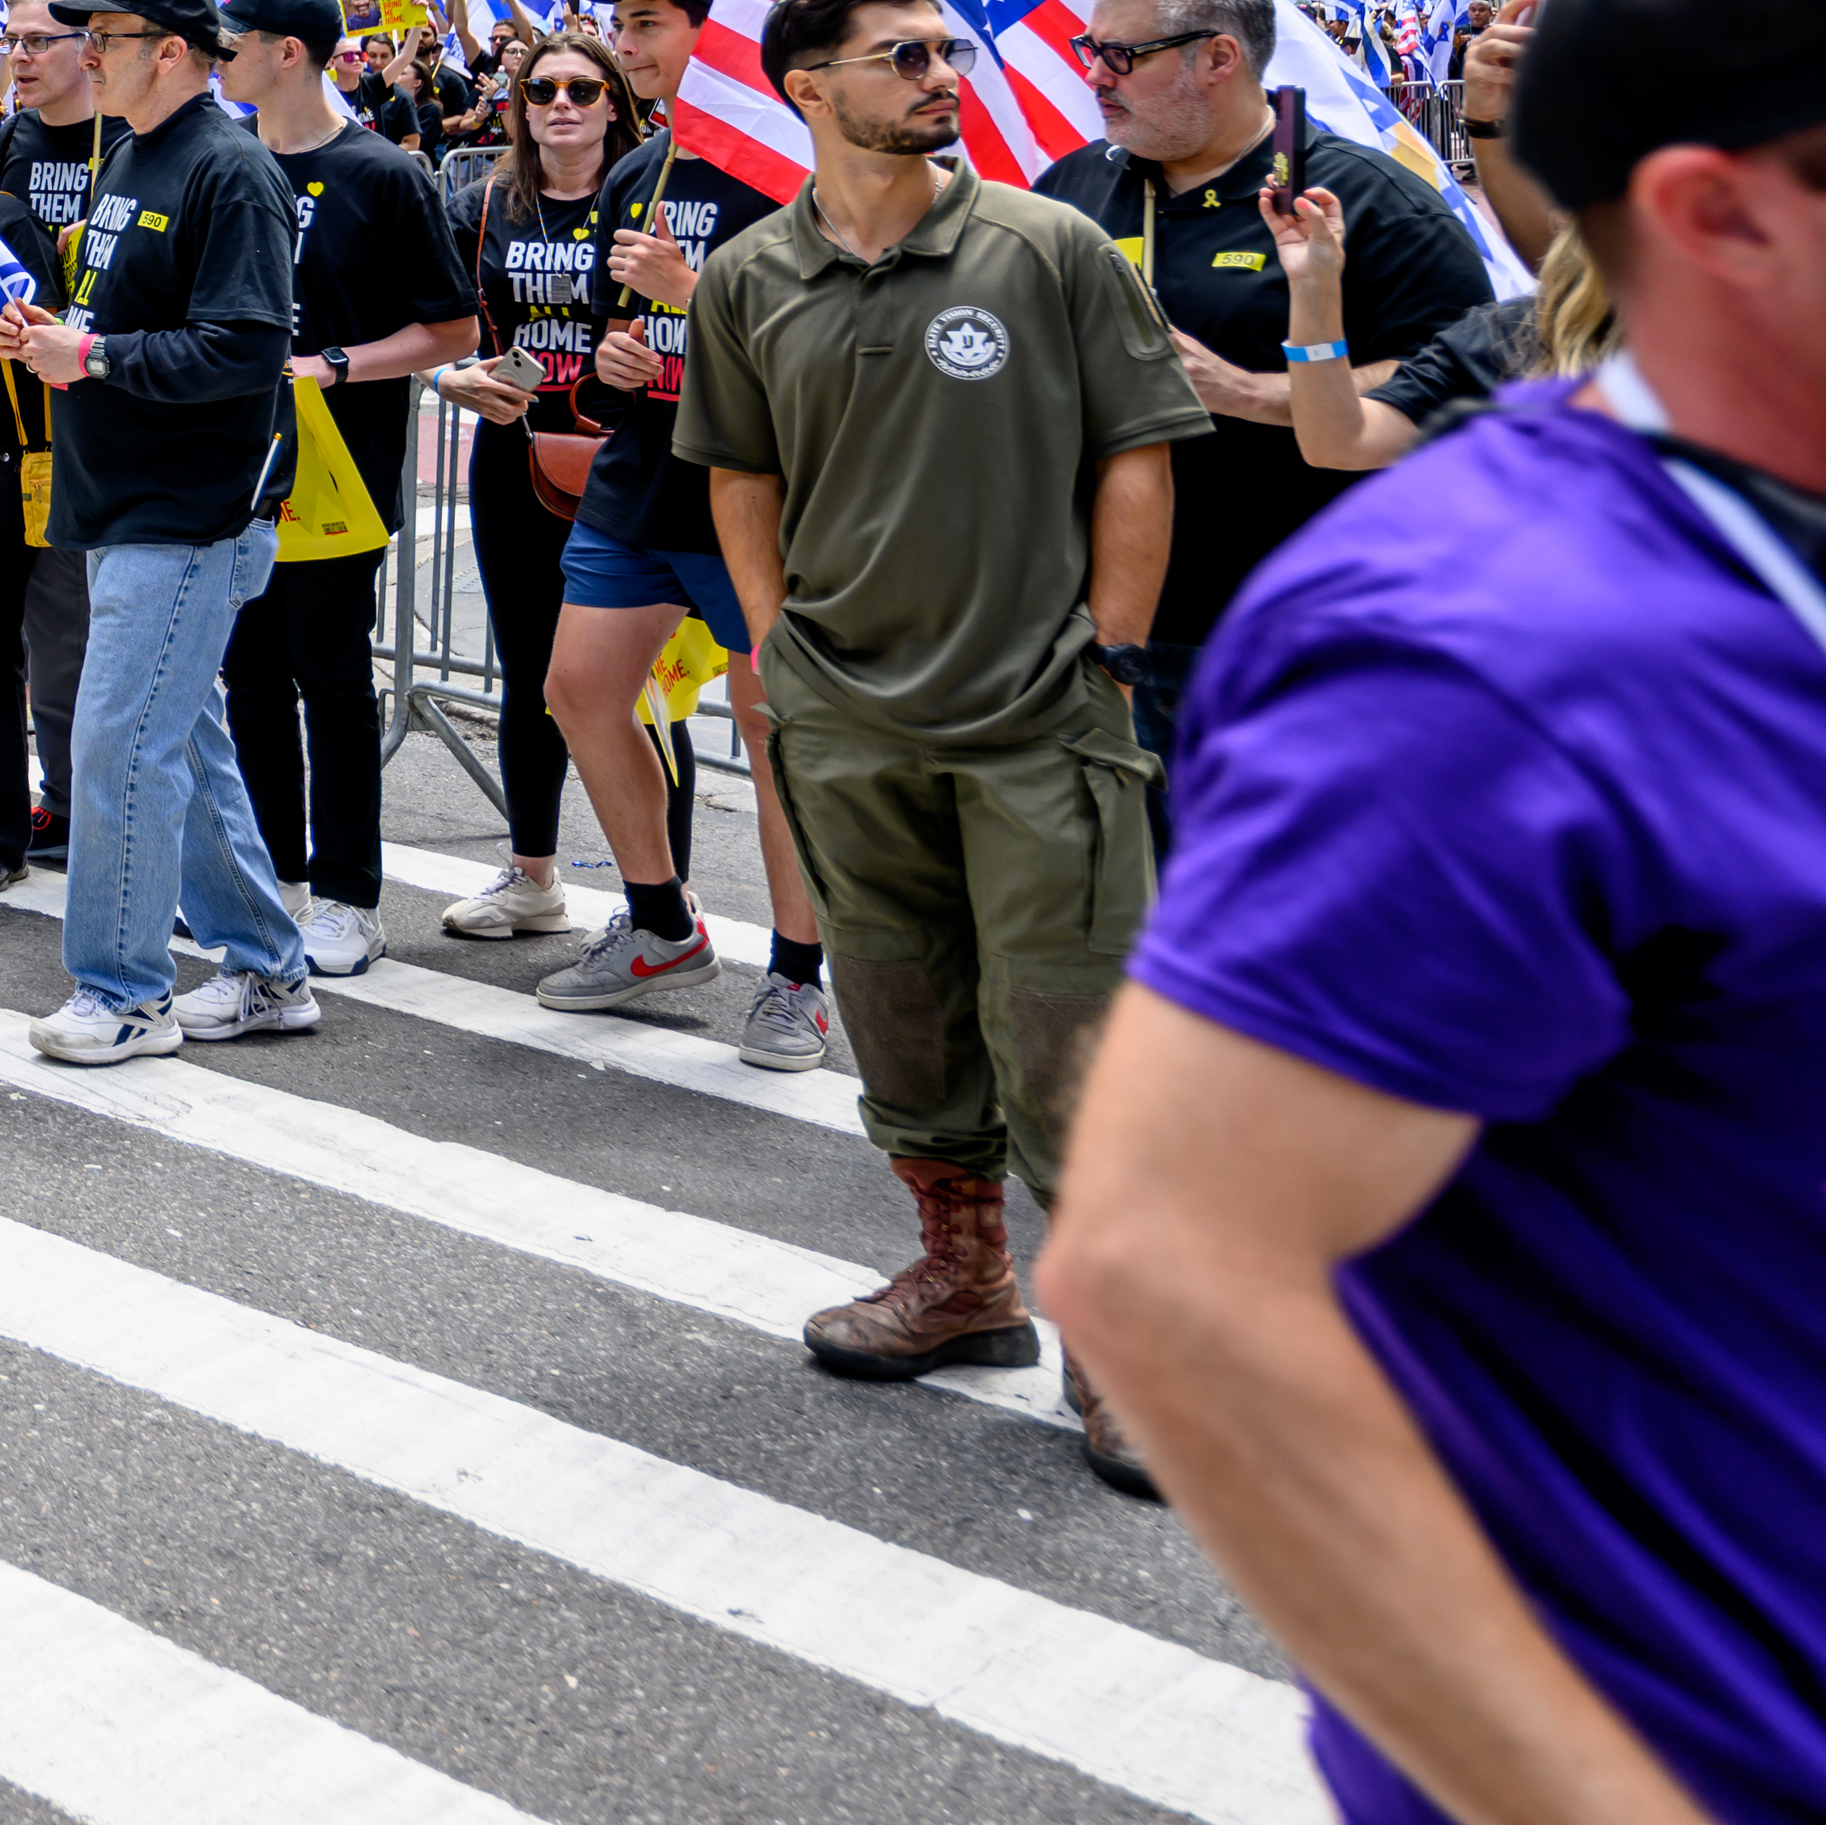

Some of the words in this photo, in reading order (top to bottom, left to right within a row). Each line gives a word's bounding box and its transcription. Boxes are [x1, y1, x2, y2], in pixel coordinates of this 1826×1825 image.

[29, 162, 89, 191] BRING
[29, 193, 81, 223] THEM
[142, 213, 162, 228] 590
[505, 241, 594, 271] BRING
[1221, 253, 1255, 268] 590
[513, 318, 592, 353] HOME
